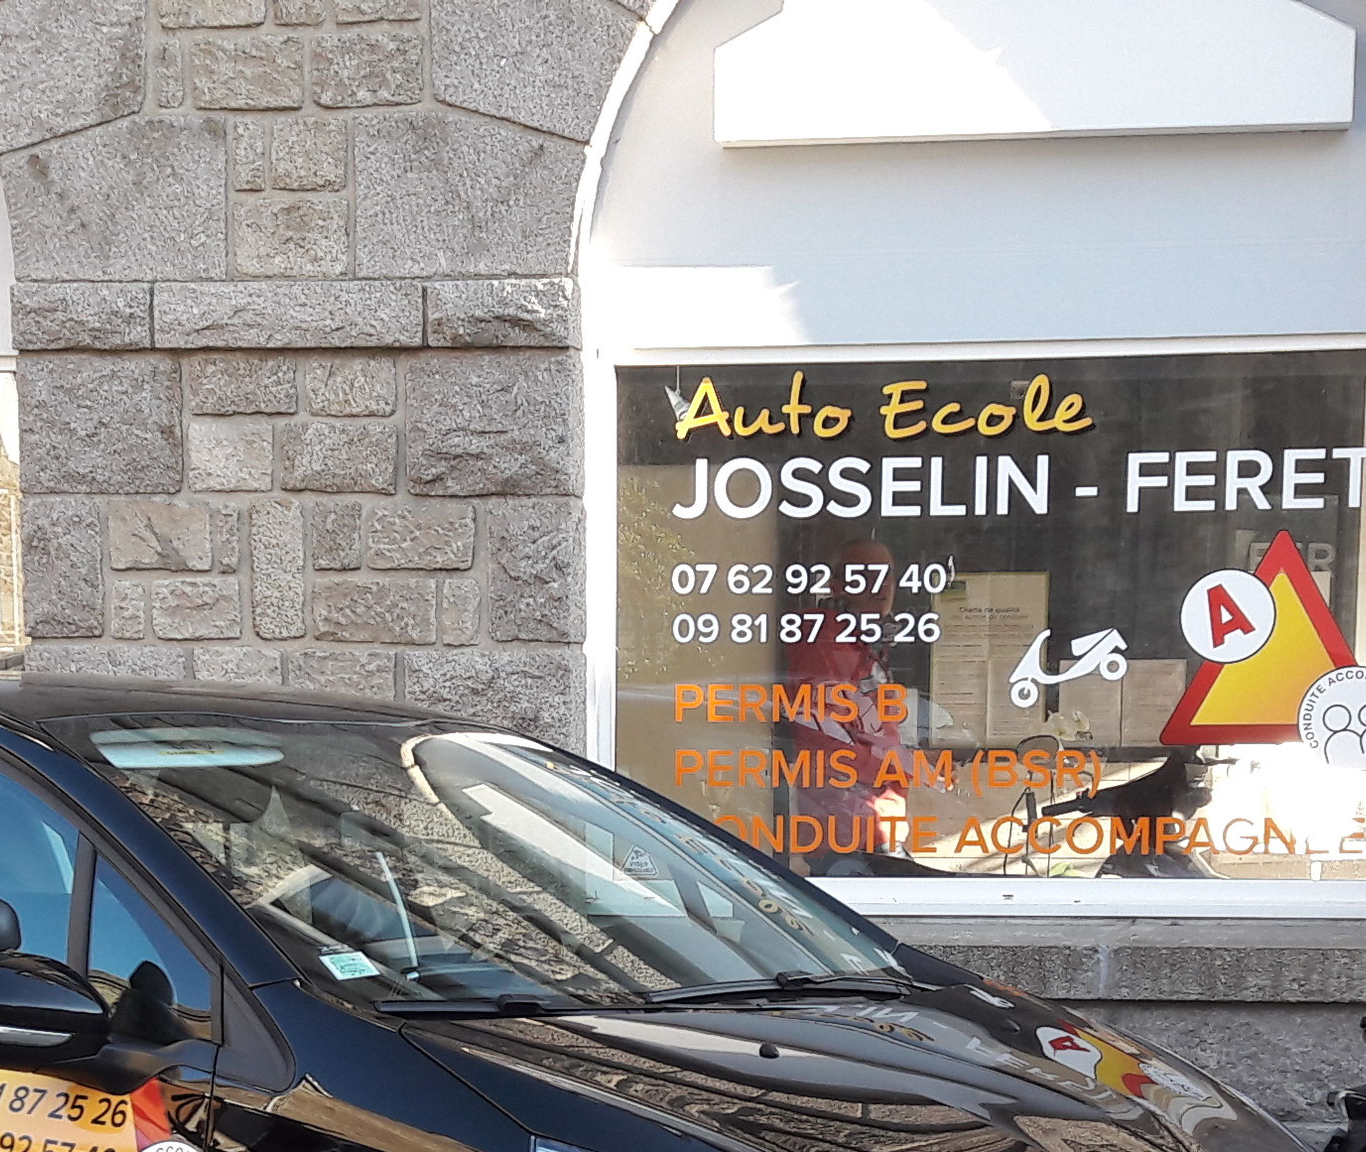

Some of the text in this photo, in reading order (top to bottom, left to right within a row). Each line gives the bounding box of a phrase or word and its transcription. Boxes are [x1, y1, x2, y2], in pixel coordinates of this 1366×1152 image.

[676, 371, 1094, 440] Auto Ecole
[672, 455, 1050, 519] JOSSELIN
[1075, 486, 1098, 497] -
[671, 564, 947, 594] 07 62 92 57 40
[672, 613, 940, 643] 09 81 87 25 26
[1206, 583, 1256, 649] A
[674, 684, 909, 723] PERMIS B
[1303, 684, 1326, 749] CONDUITE
[675, 748, 1102, 798] PERMIS AM (BSR)
[713, 815, 936, 854] ONDUITE
[8, 1085, 47, 1115] 87
[48, 1091, 88, 1122] 25
[90, 1098, 128, 1128] 26
